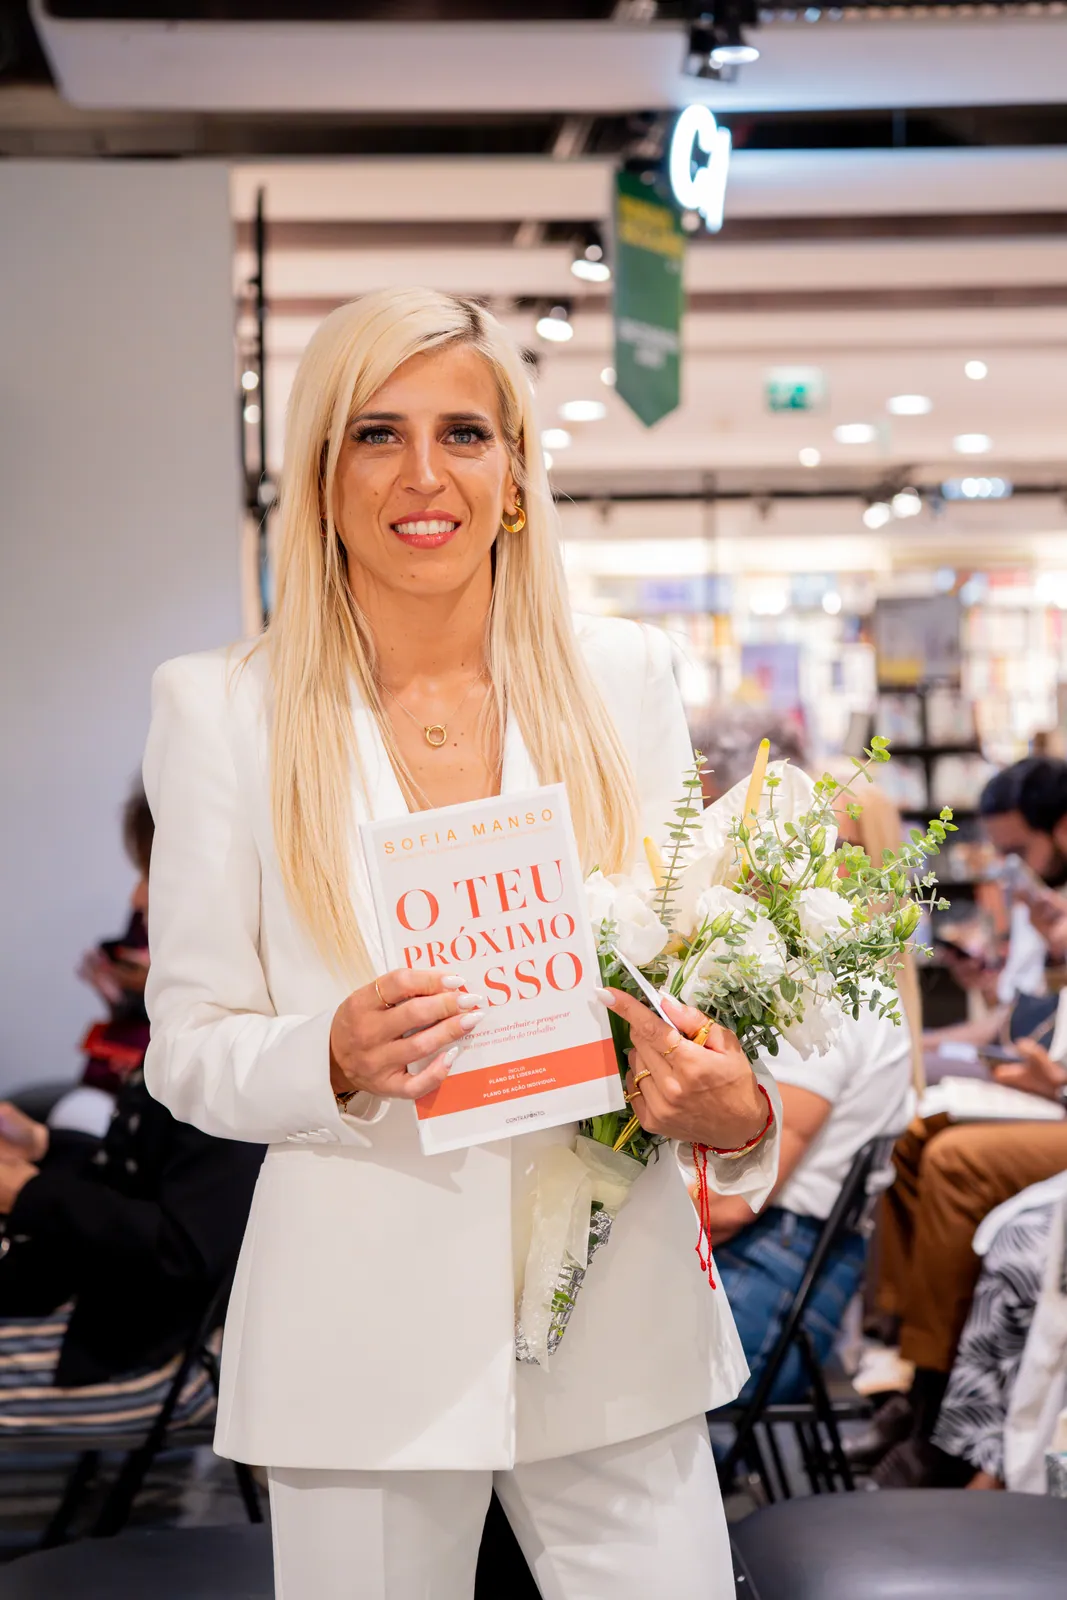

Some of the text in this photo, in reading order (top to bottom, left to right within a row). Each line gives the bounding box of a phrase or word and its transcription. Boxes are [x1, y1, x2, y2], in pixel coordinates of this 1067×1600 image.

[384, 829, 457, 854] SOFIA
[472, 809, 553, 837] MANSO
[396, 859, 564, 932] O TEU
[403, 912, 575, 970] PRÓXIMO
[456, 951, 583, 1010] SSO
[483, 1090, 502, 1098] PLANO
[511, 1085, 526, 1093] AÇÃO
[527, 1077, 557, 1089] INDIVIDUAL
[489, 1077, 507, 1085] PLANO
[516, 1067, 546, 1079] LIDERANÇA
